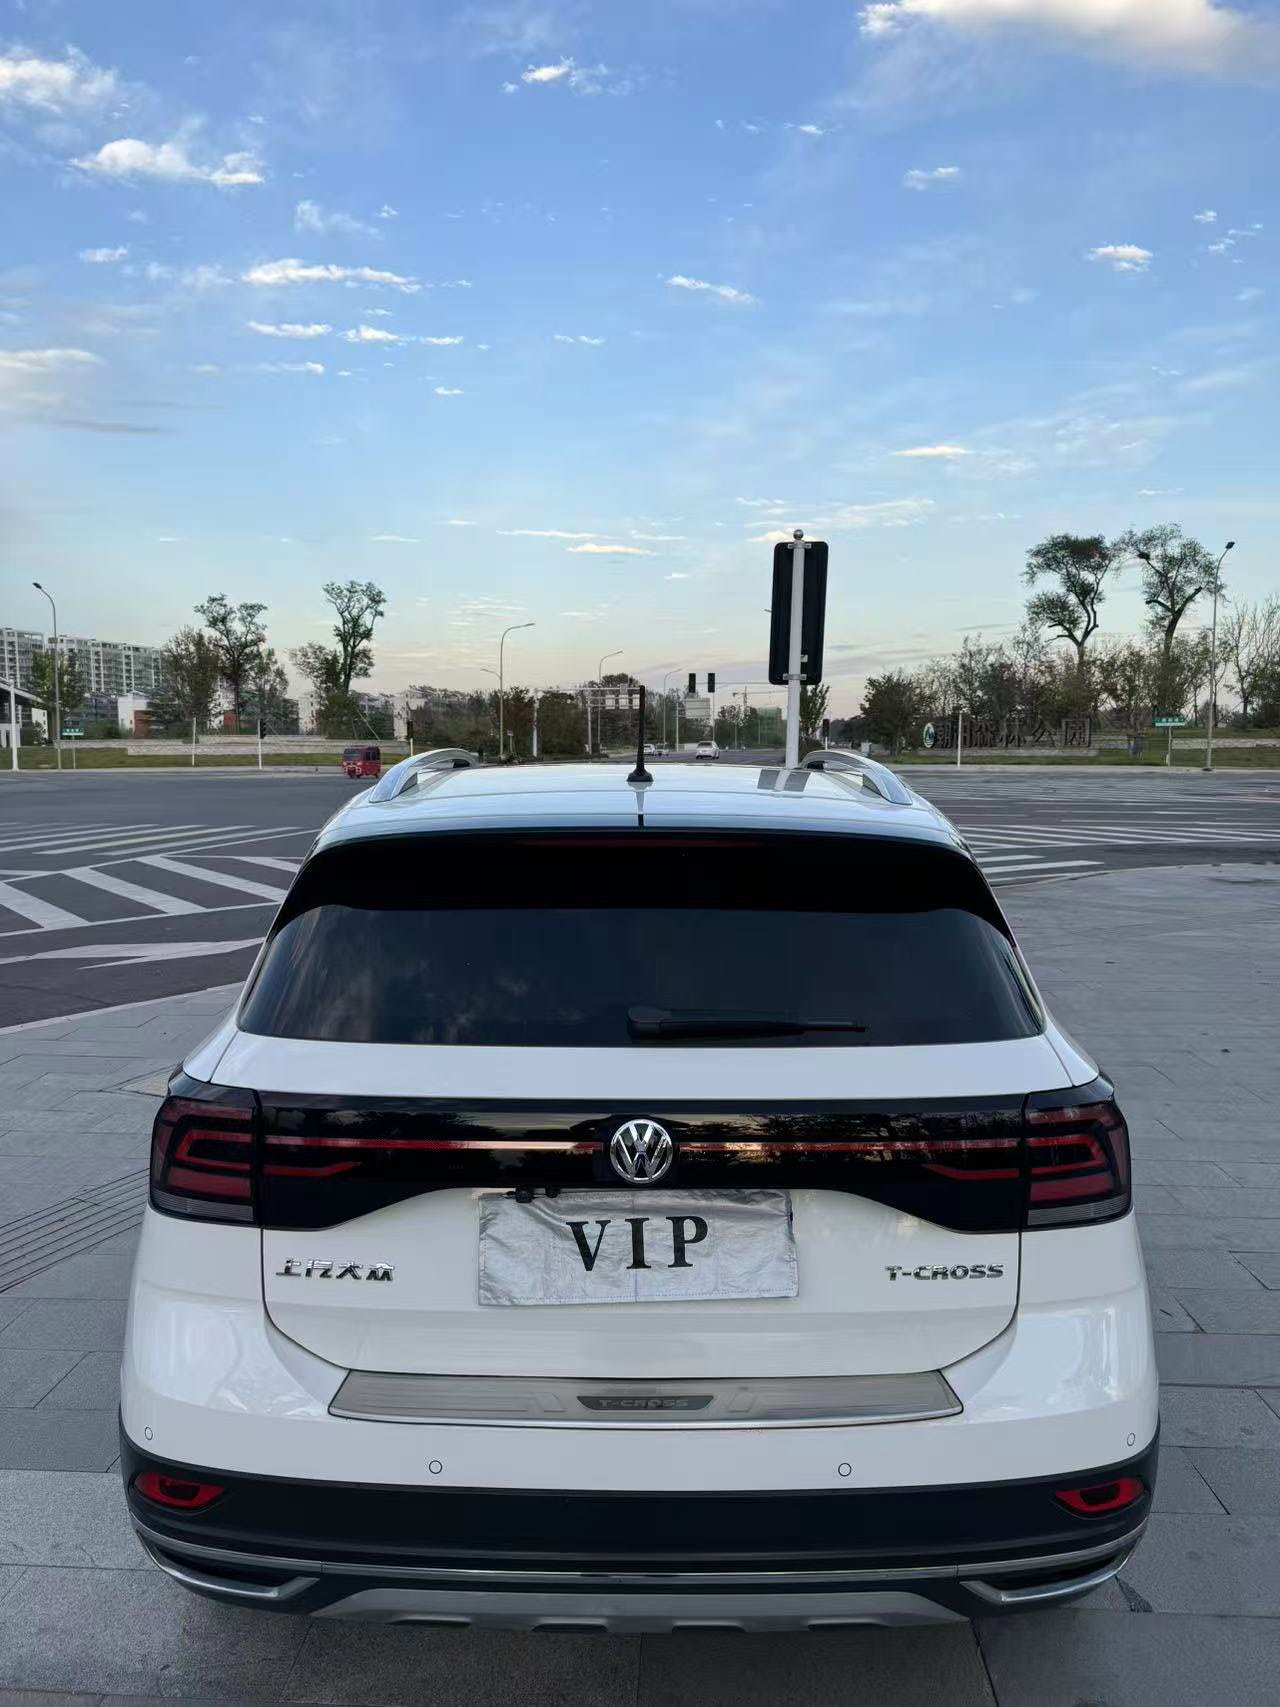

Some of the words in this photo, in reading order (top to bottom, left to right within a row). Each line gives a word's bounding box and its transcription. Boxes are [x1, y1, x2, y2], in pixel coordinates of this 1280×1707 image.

[566, 1216, 708, 1271] VIP
[276, 1259, 394, 1281] 上汽大众
[885, 1264, 1004, 1281] T-CROSS
